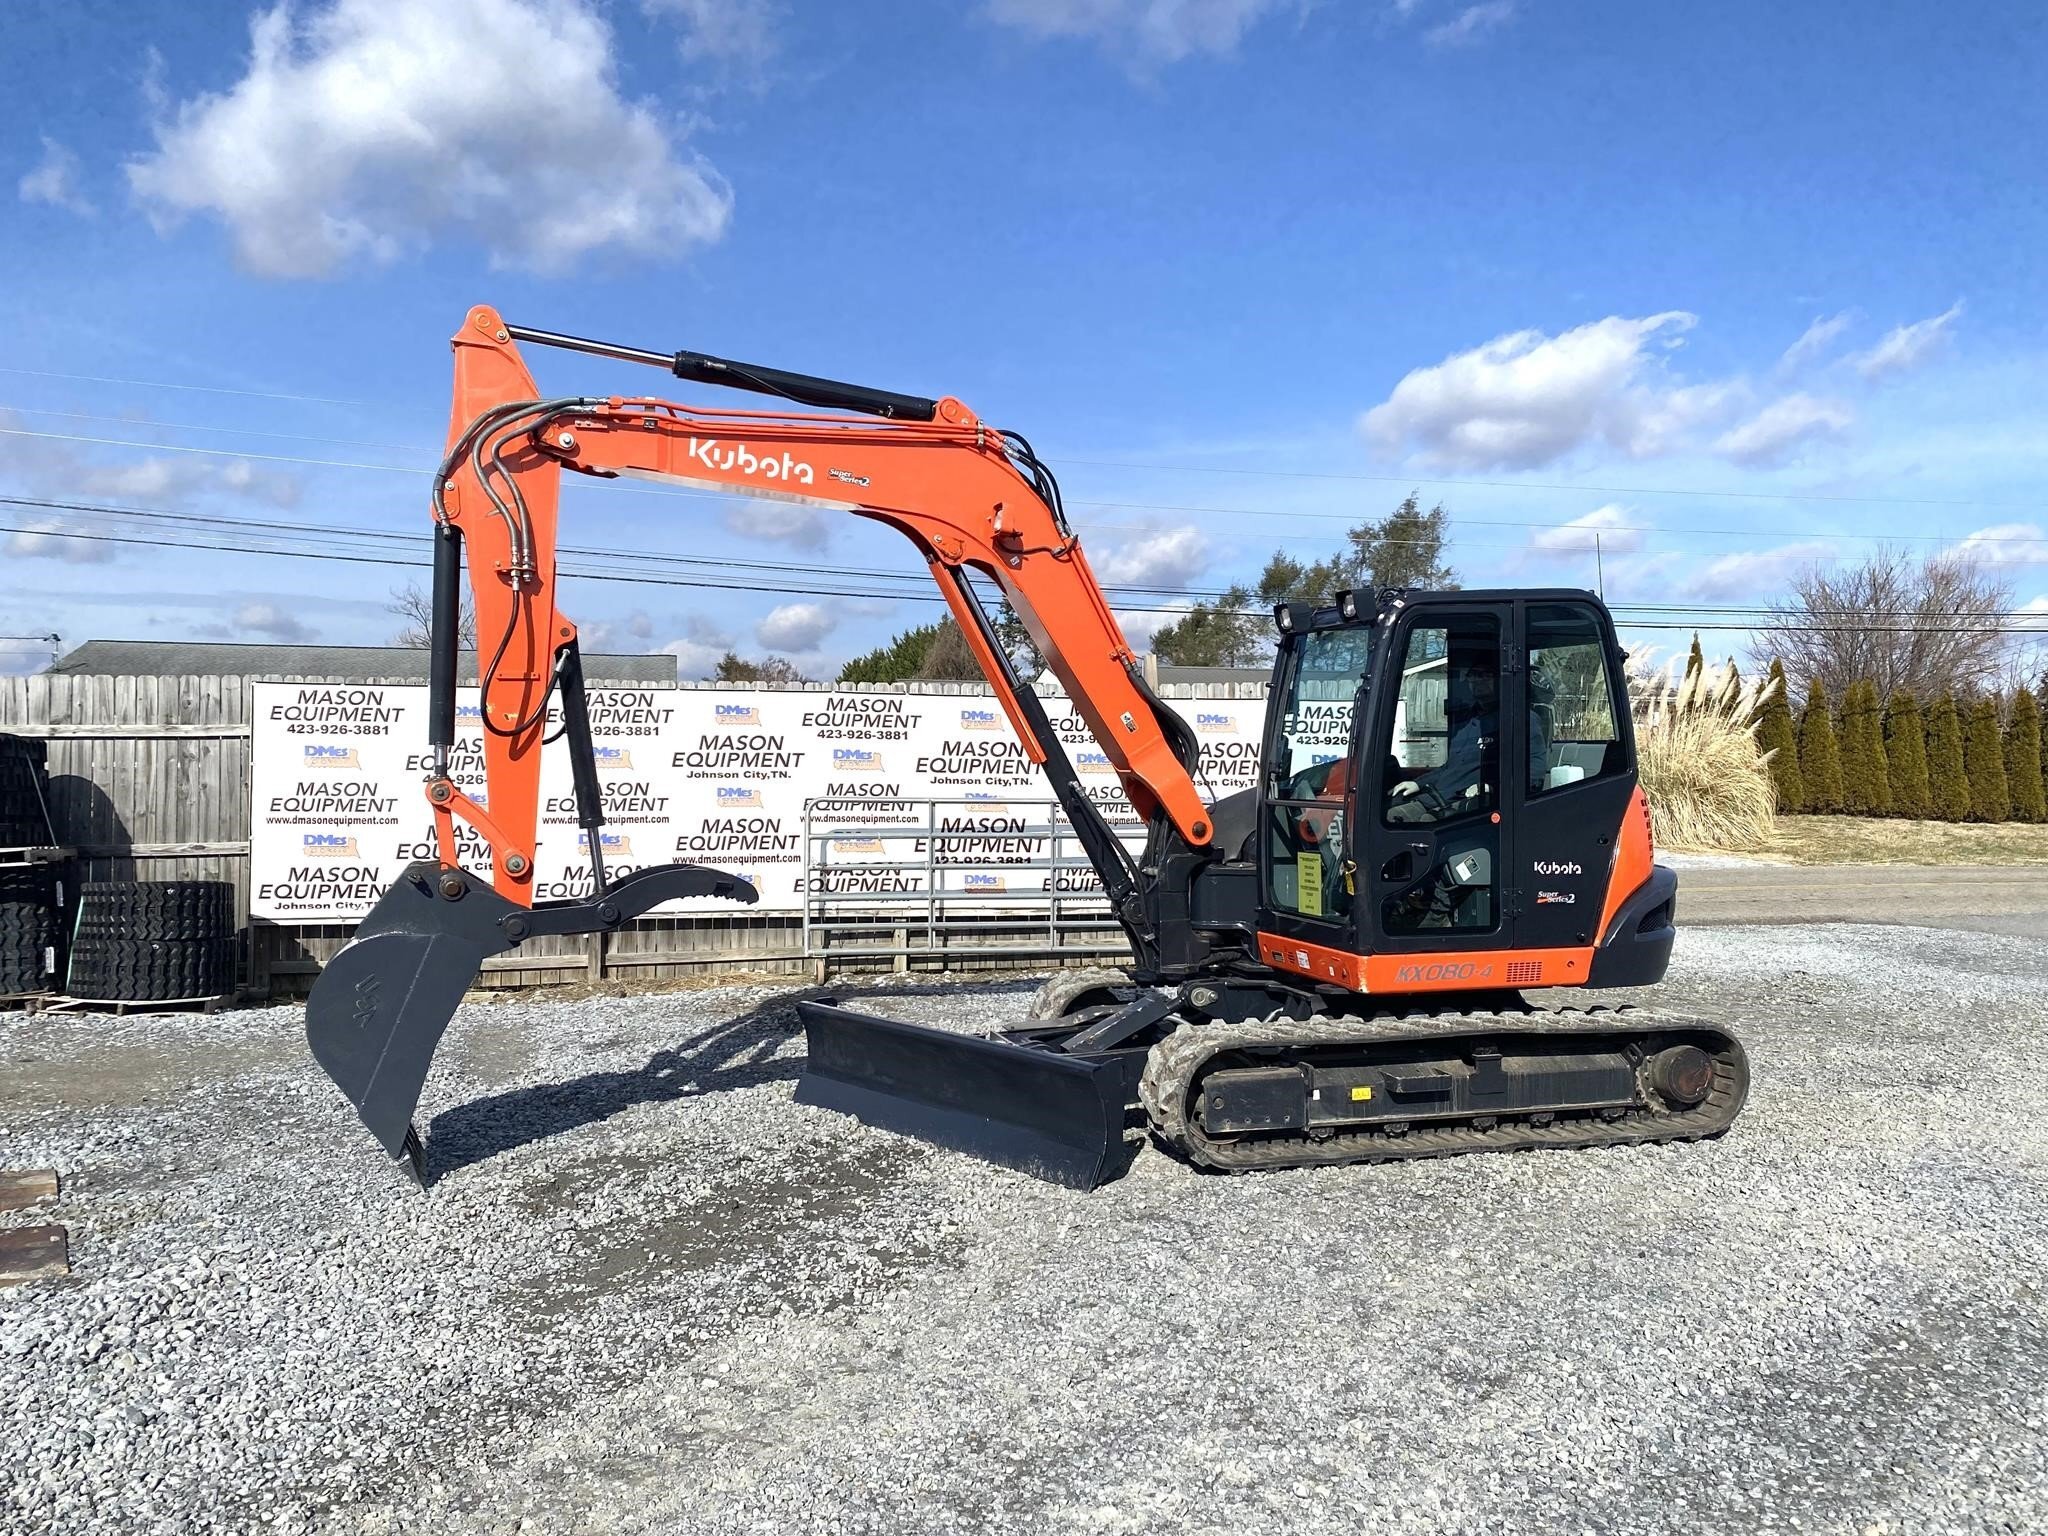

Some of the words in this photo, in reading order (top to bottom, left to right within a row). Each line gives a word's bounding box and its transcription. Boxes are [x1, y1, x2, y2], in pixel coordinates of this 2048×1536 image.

[688, 436, 814, 485] Kubota
[298, 690, 384, 706] MASON
[826, 698, 903, 712] MASON
[270, 706, 405, 722] EQUIPMENT
[802, 713, 922, 728] EQUIPMENT
[287, 724, 389, 735] 423-926-3881
[817, 730, 908, 740] 423-926-3881
[699, 735, 784, 750] MASON
[942, 741, 1023, 757] MASON
[1199, 742, 1260, 758] ASON
[672, 752, 805, 768] EQUIPMENT
[686, 770, 739, 778] Johnson
[930, 776, 982, 784] Johnson
[296, 782, 378, 796] MASON
[826, 784, 900, 796] MASON
[270, 798, 398, 812] EQUIPMENT
[266, 815, 399, 827] www.dmasonequipment.com
[701, 818, 781, 834] MASON
[941, 818, 1026, 832] MASON
[676, 835, 800, 850] EQUIPMENT
[672, 854, 801, 865] www.dmasonequipment.com
[288, 867, 379, 882] MASON
[1534, 861, 1582, 874] Kubota
[794, 878, 922, 892] EQUIPMENT
[274, 902, 331, 910] Johnson
[1395, 963, 1494, 982] KX080-4
